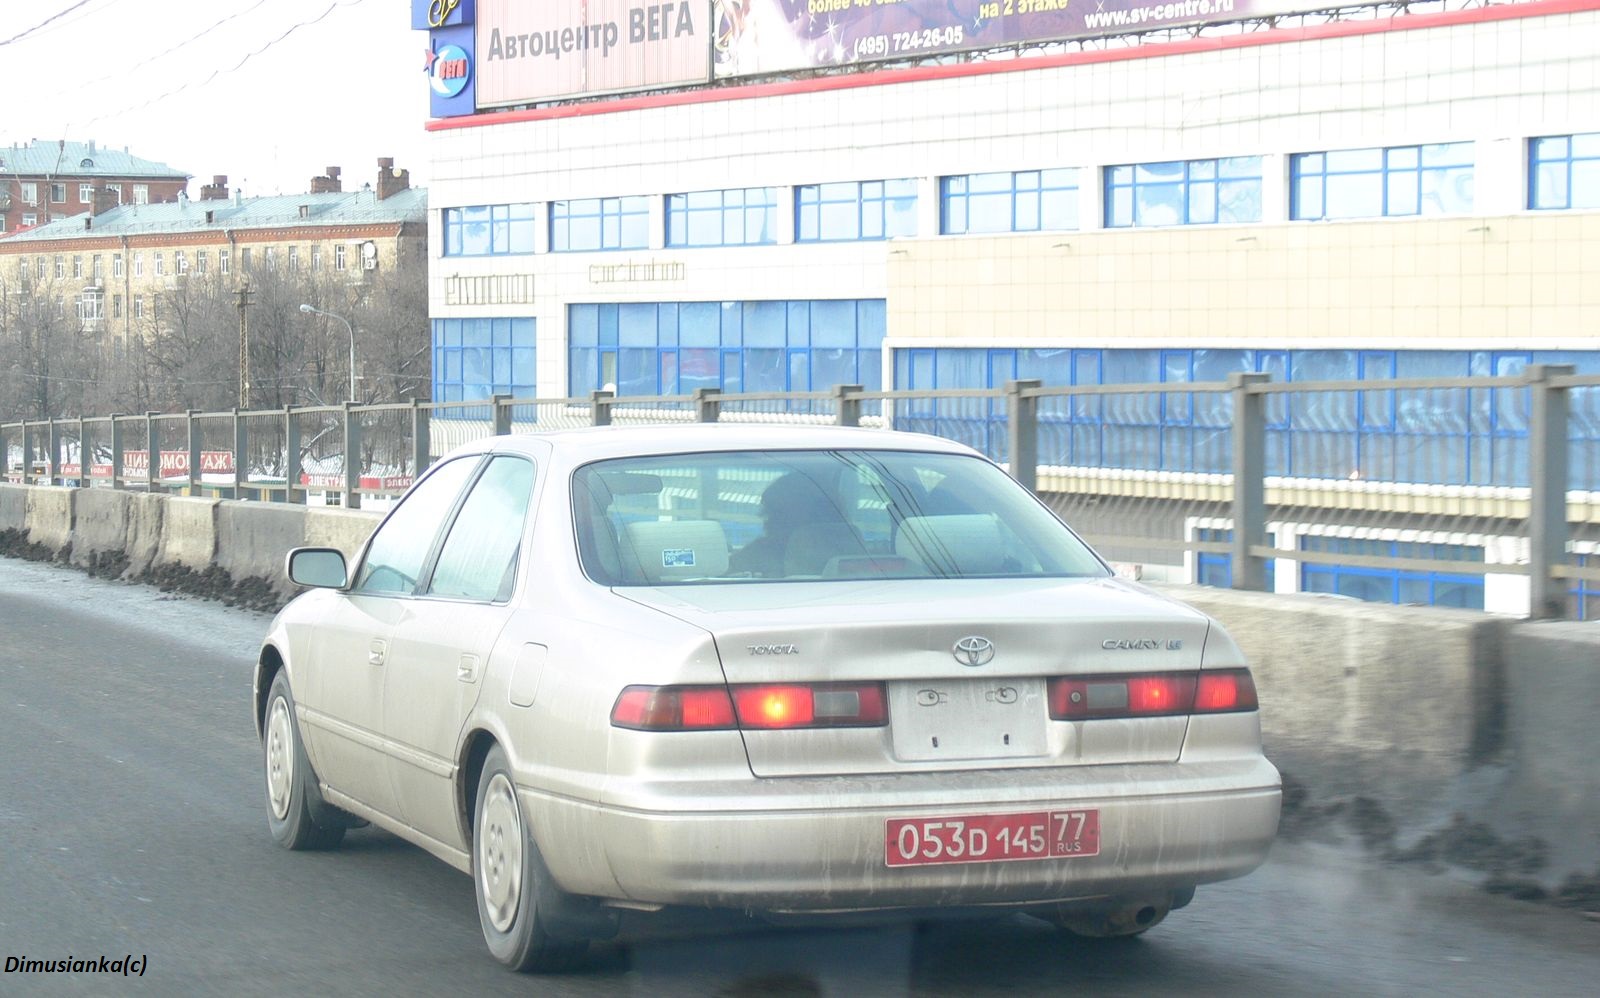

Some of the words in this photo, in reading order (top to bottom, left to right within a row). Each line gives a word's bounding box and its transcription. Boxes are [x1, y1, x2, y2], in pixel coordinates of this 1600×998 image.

[980, 3, 999, 19] на
[1003, 0, 1013, 16] 2
[1084, 0, 1234, 29] www.sv-centre.ru
[487, 21, 618, 62] Автоцентр
[629, 0, 695, 44] ВЕГА
[854, 34, 888, 59] (495)
[893, 25, 963, 52] 724-26-05
[746, 644, 800, 656] TOYOTA
[1102, 639, 1162, 650] CAMRY
[995, 825, 1045, 854] 145
[1054, 812, 1087, 842] 77
[1057, 841, 1082, 853] RUS
